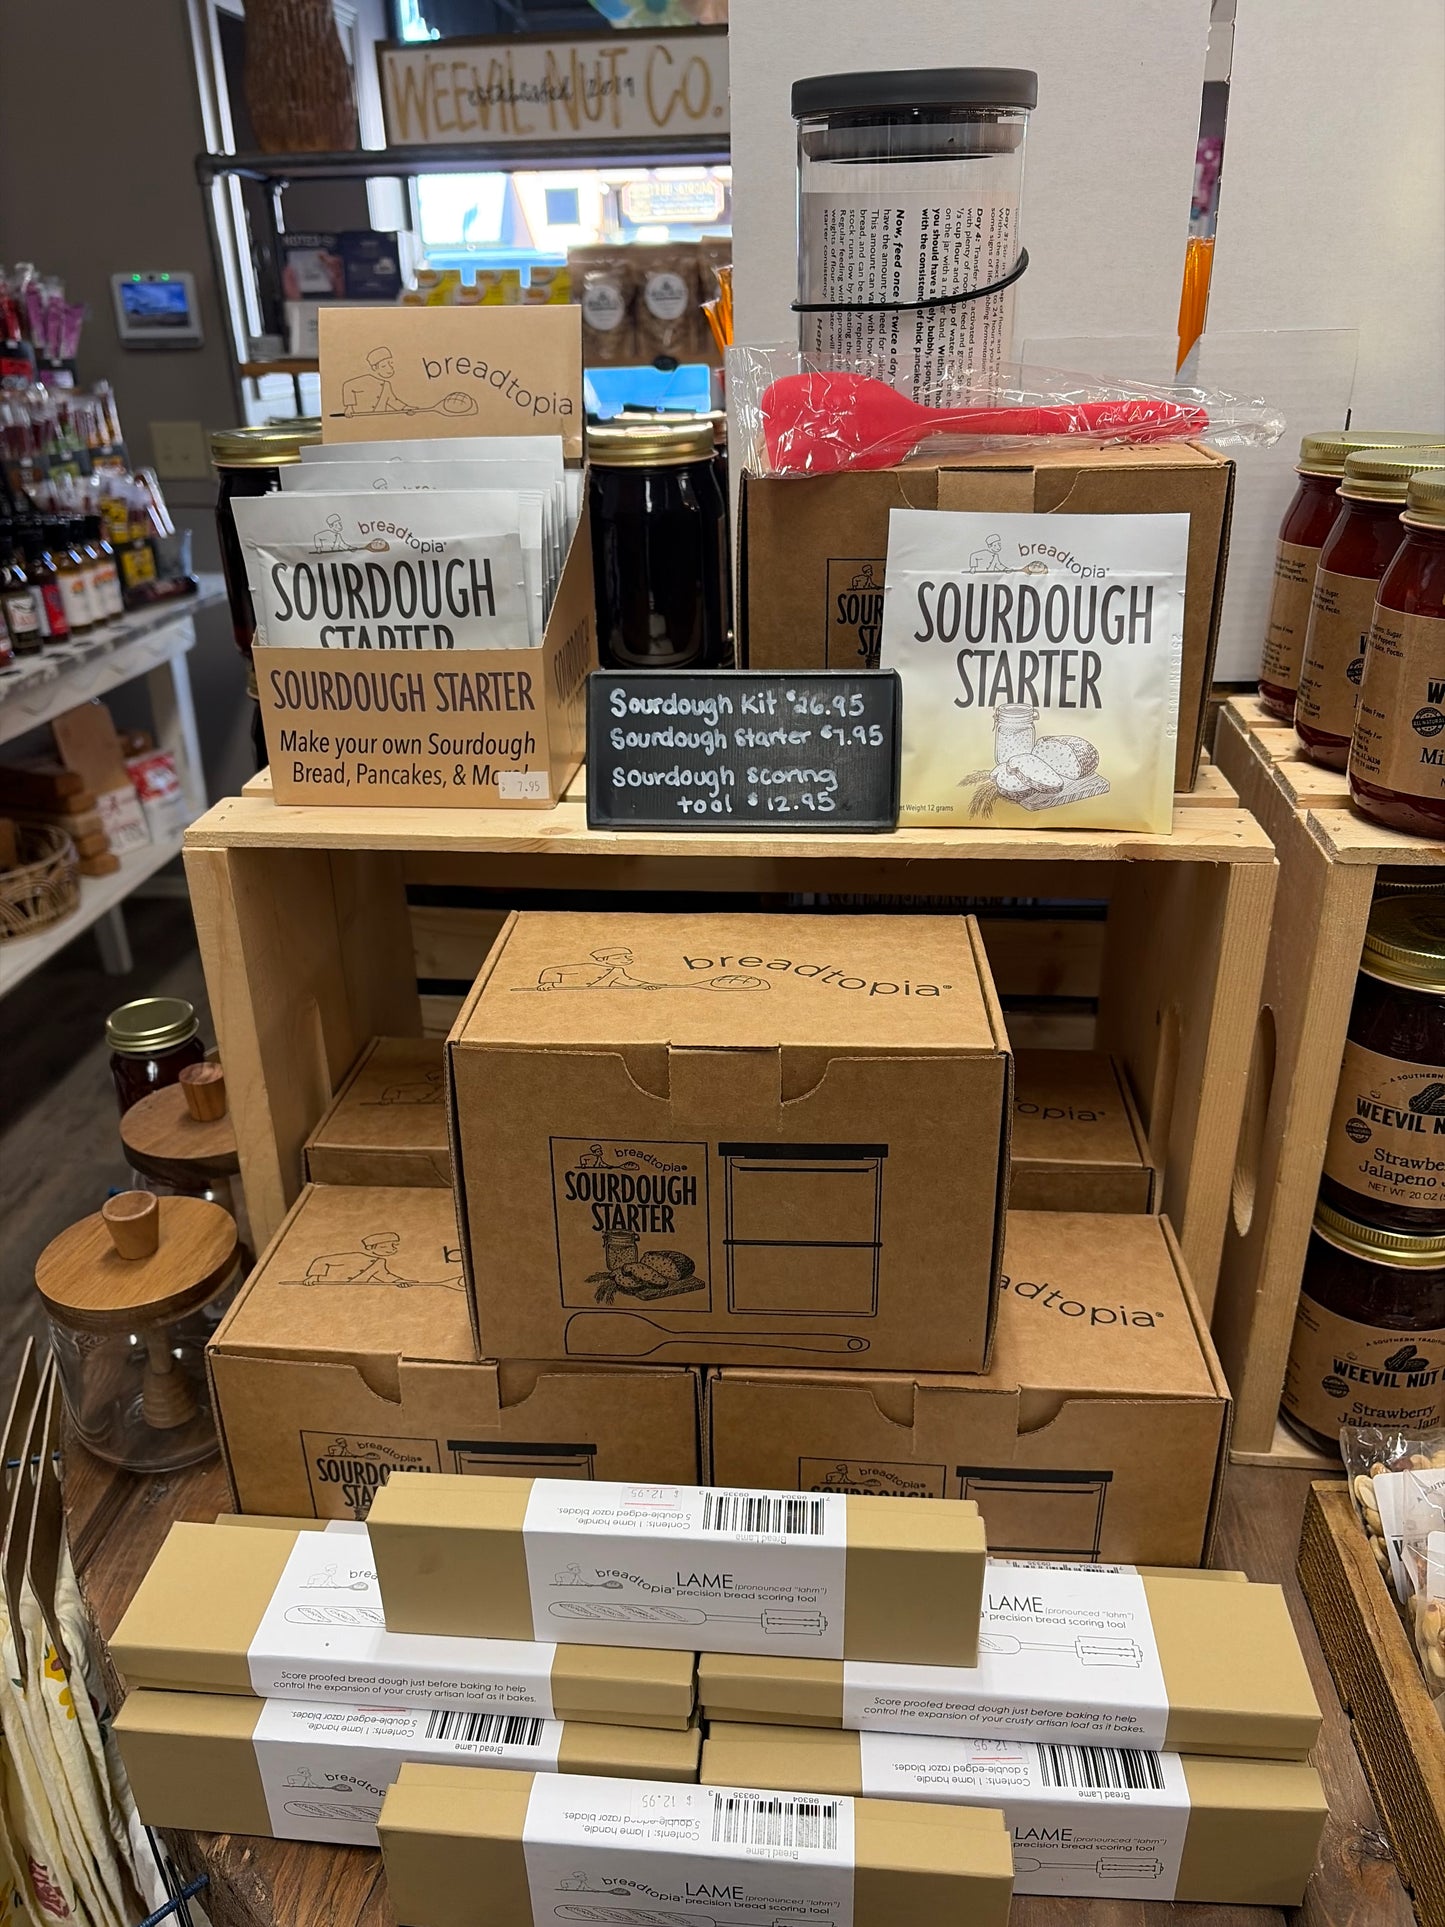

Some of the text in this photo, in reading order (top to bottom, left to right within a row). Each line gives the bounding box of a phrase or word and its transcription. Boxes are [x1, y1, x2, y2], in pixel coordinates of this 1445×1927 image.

[388, 50, 535, 140] WEEVIL
[547, 48, 628, 131] NUT
[859, 210, 868, 240] bread,
[871, 210, 880, 230] This
[894, 209, 904, 238] Now,
[932, 208, 940, 226] you
[946, 208, 952, 220] on
[975, 208, 983, 229] Day
[920, 234, 928, 250] the
[944, 223, 952, 238] the
[954, 222, 962, 239] cup
[975, 232, 981, 242] 4:
[830, 248, 836, 260] of
[837, 210, 846, 282] Regular feeding
[858, 241, 866, 258] and
[880, 209, 892, 289] have the amount
[893, 242, 903, 268] feed
[932, 229, 940, 261] should
[942, 241, 951, 252] jar
[954, 242, 962, 265] flour
[963, 231, 972, 257] plenty
[918, 252, 926, 301] consistenc
[930, 264, 938, 286] have
[942, 256, 950, 274] with
[964, 261, 970, 270] of
[917, 310, 924, 319] of
[878, 338, 886, 350] for
[888, 316, 900, 377] twice day
[422, 356, 574, 417] breadtopia
[271, 558, 497, 622] SOURDOUGH
[913, 581, 1154, 645] SOURDOUGH
[270, 669, 536, 712] SOURDOUGH STARTER
[954, 649, 1102, 709] STARTER
[609, 688, 733, 726] Sourdough
[741, 691, 778, 715] Kit
[280, 730, 536, 761] Make your own Sourdough
[609, 726, 727, 756] Sourdough
[292, 761, 467, 789] Bread, Pancakes, &
[612, 765, 735, 798] Sourdough
[676, 793, 733, 814] tool
[1356, 1097, 1427, 1133] WEEVIL
[1359, 1160, 1437, 1187] Jalapeno
[565, 1172, 698, 1206] SOURDOUGH
[1368, 1181, 1387, 1192] NET
[591, 1202, 675, 1234] STARTER
[1333, 1358, 1439, 1388] WEEVIL NUT
[1352, 1401, 1436, 1420] Strawberry
[676, 1572, 734, 1589] LAME
[676, 1588, 817, 1603] precision bread scoring tool
[988, 1594, 1044, 1613] LAME
[989, 1613, 1127, 1629] precision bread scoring tool
[273, 1681, 306, 1690] control
[307, 1682, 322, 1690] the
[324, 1684, 371, 1693] expansion
[383, 1687, 404, 1696] your
[405, 1688, 432, 1698] crusty
[434, 1690, 465, 1699] artisan
[466, 1691, 485, 1700] loaf
[506, 1694, 537, 1703] bakes.
[281, 1671, 307, 1680] Score
[309, 1673, 346, 1683] proofed
[348, 1675, 376, 1684] bread
[378, 1677, 408, 1687] dough
[409, 1679, 425, 1688] just
[427, 1680, 458, 1689] before
[460, 1682, 491, 1692] baking
[505, 1685, 527, 1694] help
[1015, 1827, 1073, 1841] LAME
[685, 1882, 744, 1900] LAME
